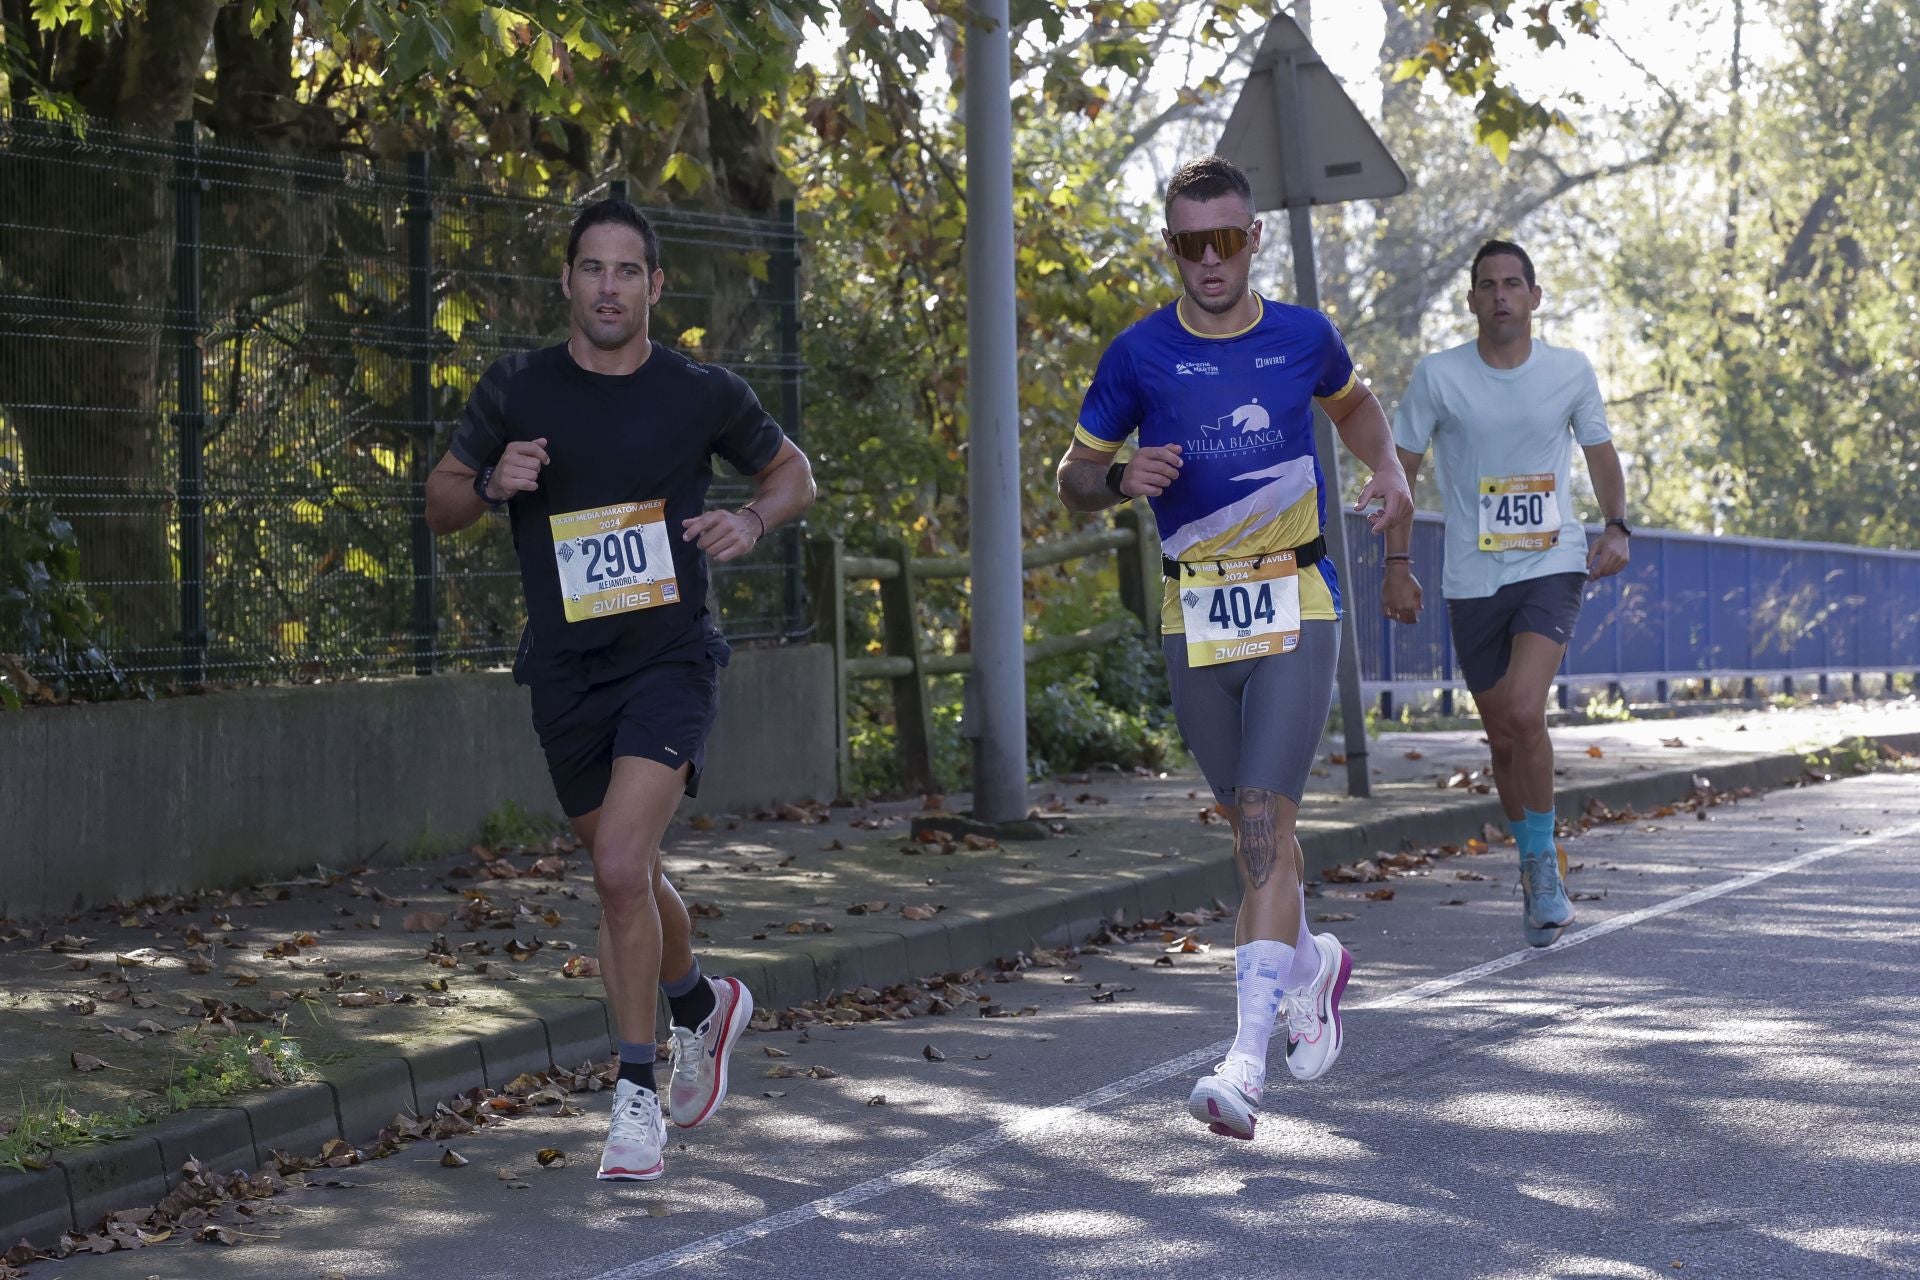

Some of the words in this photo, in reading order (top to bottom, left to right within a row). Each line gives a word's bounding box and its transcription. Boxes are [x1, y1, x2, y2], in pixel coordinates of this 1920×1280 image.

[1187, 439, 1225, 452] VILLA
[1230, 429, 1284, 449] BLANCA
[1496, 494, 1543, 526] 450
[576, 512, 600, 522] MEDIA
[600, 518, 621, 530] 2024
[582, 530, 647, 583] 290
[1266, 553, 1293, 565] AVILÉS
[598, 577, 632, 590] ALEJANDRO
[1224, 572, 1249, 582] 2024
[1209, 583, 1276, 629] 404
